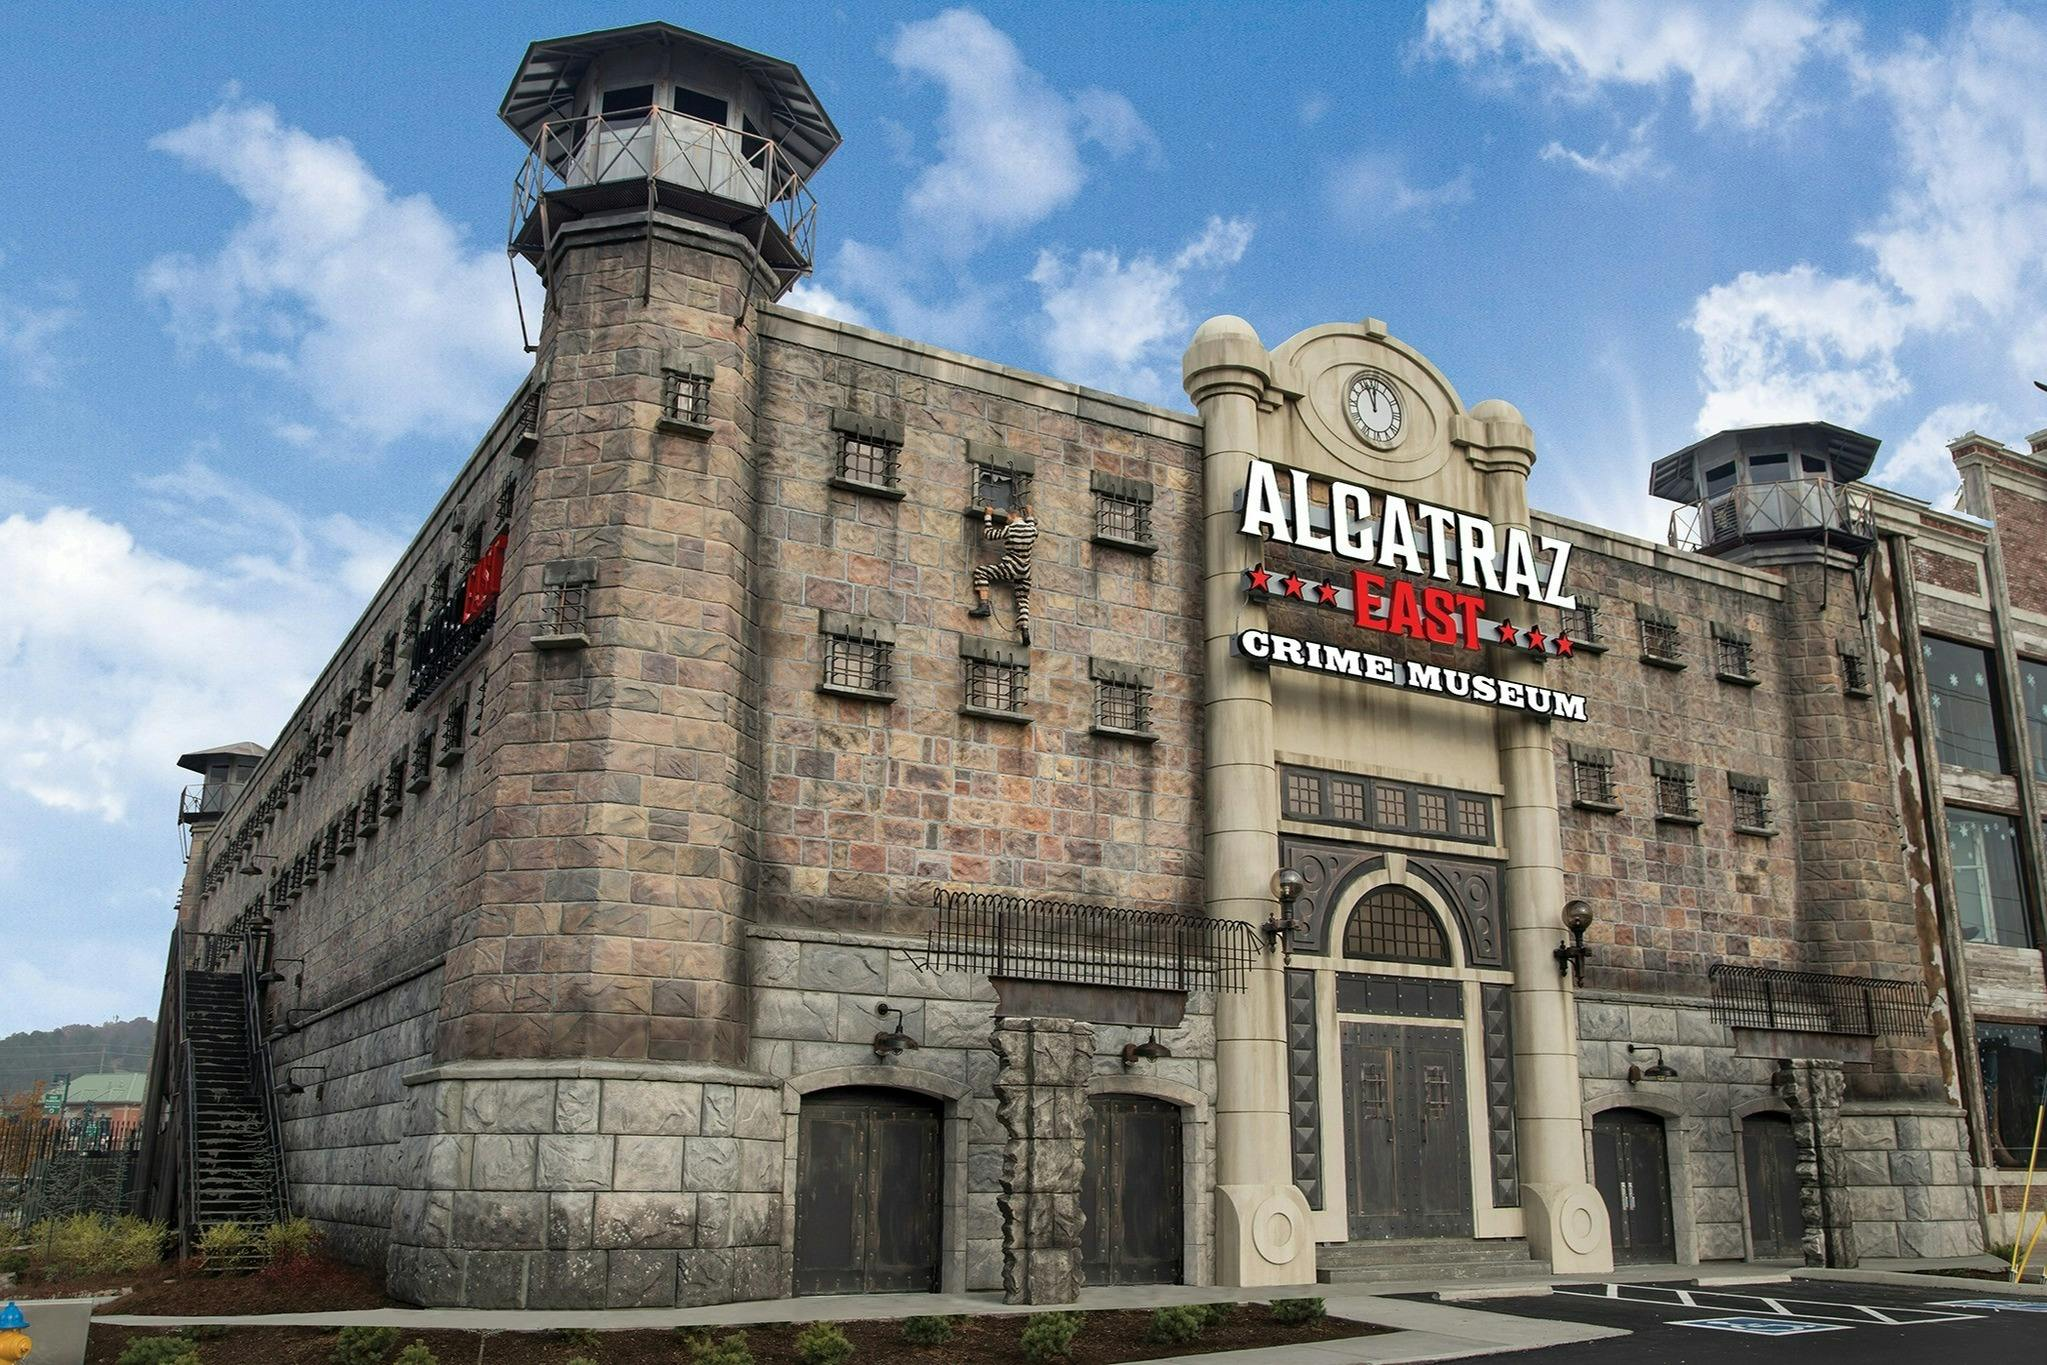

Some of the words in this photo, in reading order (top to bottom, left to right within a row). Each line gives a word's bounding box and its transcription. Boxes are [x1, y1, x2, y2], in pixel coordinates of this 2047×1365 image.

[1240, 459, 1576, 610] ALCATRAZ
[1353, 570, 1485, 651] EAST
[1241, 630, 1394, 683] CRIME
[1407, 660, 1587, 722] MUSEUM
